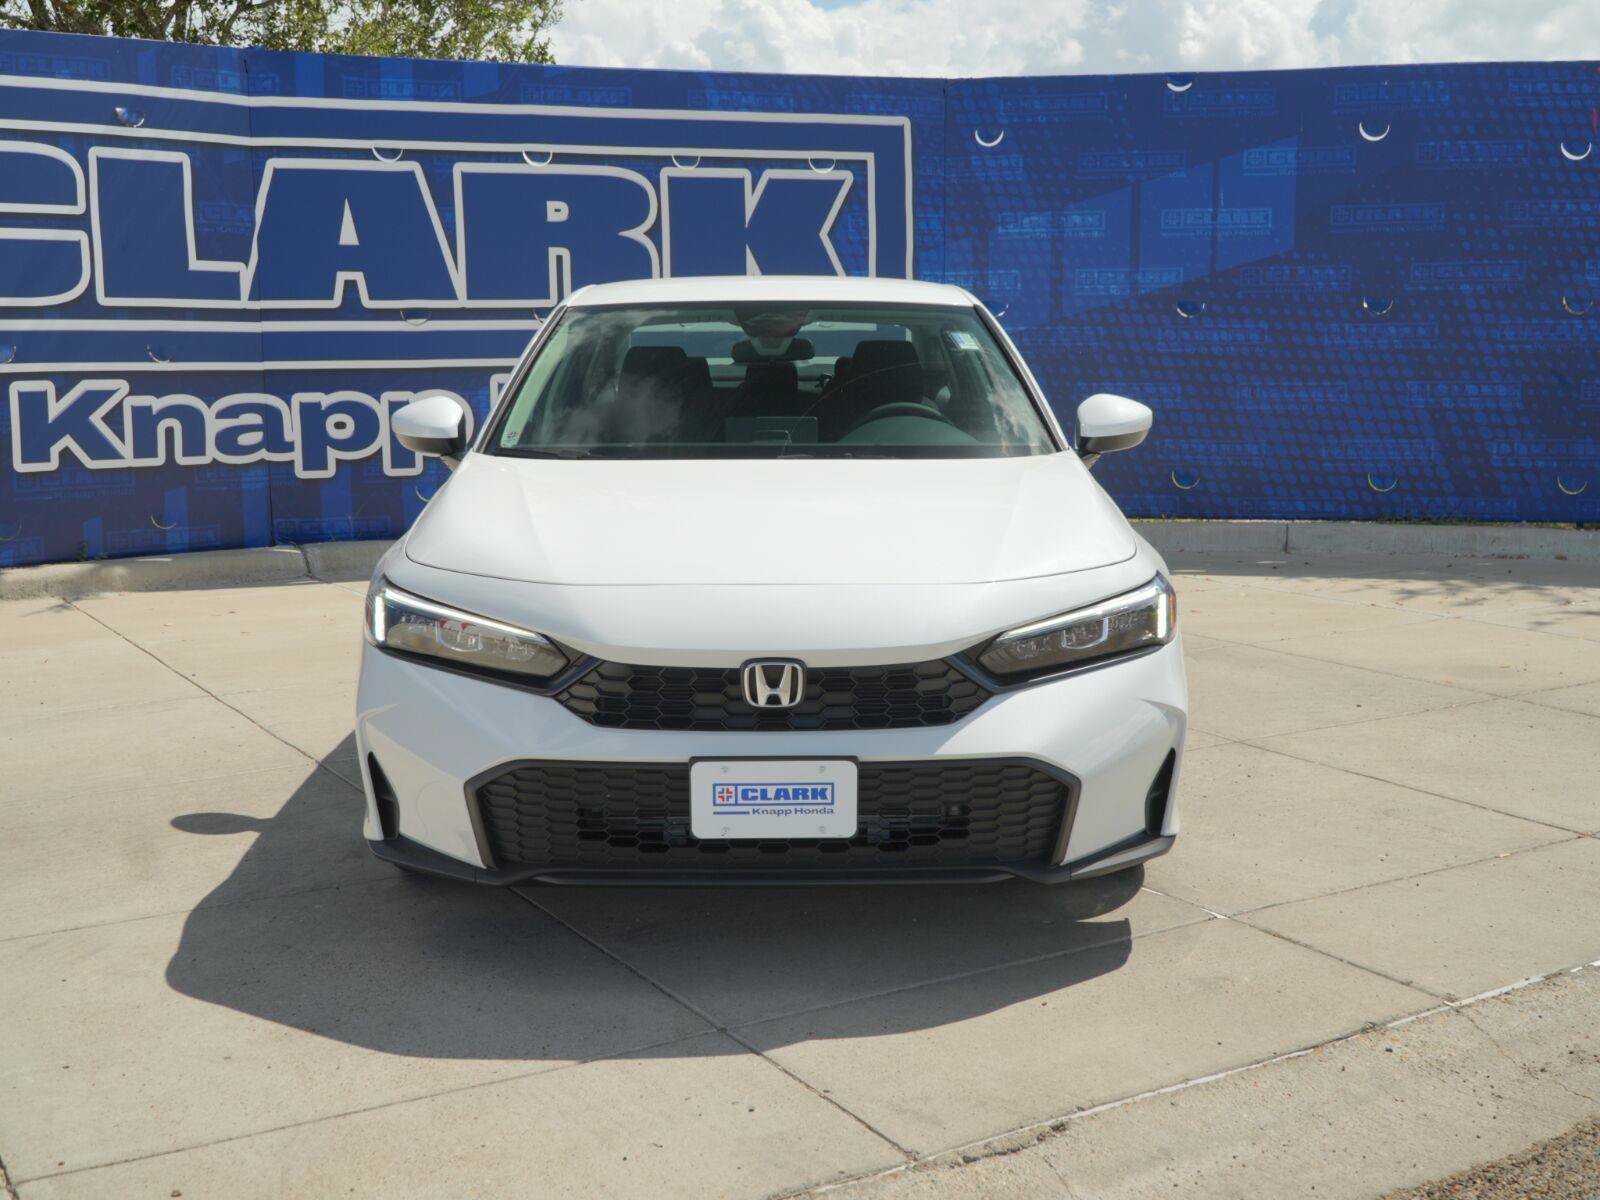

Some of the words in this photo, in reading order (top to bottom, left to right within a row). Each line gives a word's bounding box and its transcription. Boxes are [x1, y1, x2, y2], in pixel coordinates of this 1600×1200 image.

[741, 787, 829, 801] CLARK
[752, 808, 793, 816] Knapp
[794, 807, 834, 815] Honda
